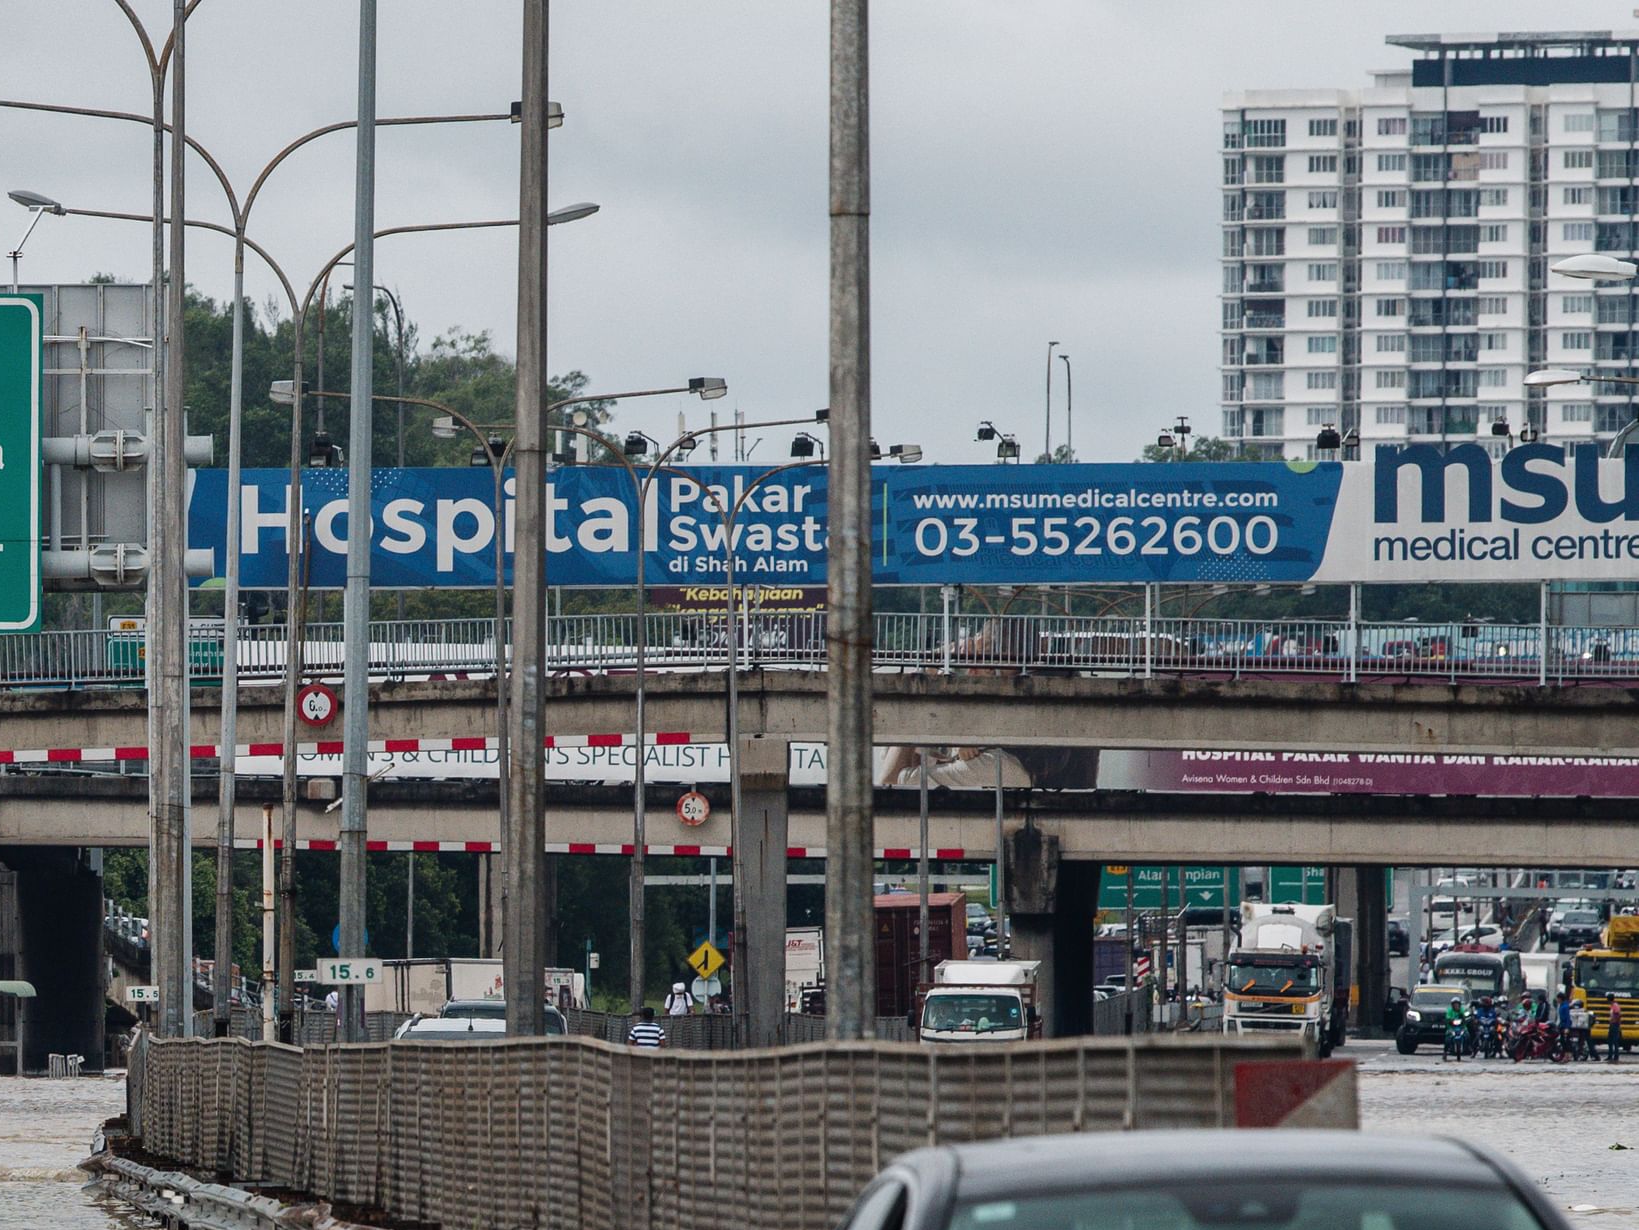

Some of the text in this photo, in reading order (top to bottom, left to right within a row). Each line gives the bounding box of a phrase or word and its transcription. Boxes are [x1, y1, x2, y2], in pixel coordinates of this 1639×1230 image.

[670, 475, 811, 513] Pakar
[1374, 443, 1639, 524] msu
[913, 489, 1278, 509] www.msumedicalcentre.com
[241, 476, 658, 572] Hospital
[668, 515, 831, 552] Swast
[914, 515, 1279, 557] 03-55262600
[1374, 528, 1520, 561] medical
[668, 556, 808, 573] di Shah Alam
[577, 744, 710, 768] SPECALIST
[1181, 774, 1213, 784] Avisena
[1216, 774, 1248, 784] Women
[1249, 775, 1257, 784] &
[1259, 774, 1294, 785] Children
[1296, 775, 1312, 785] Sdn
[1314, 774, 1330, 785] Bhd
[330, 964, 375, 980] 15.6
[131, 989, 159, 998] 15.5
